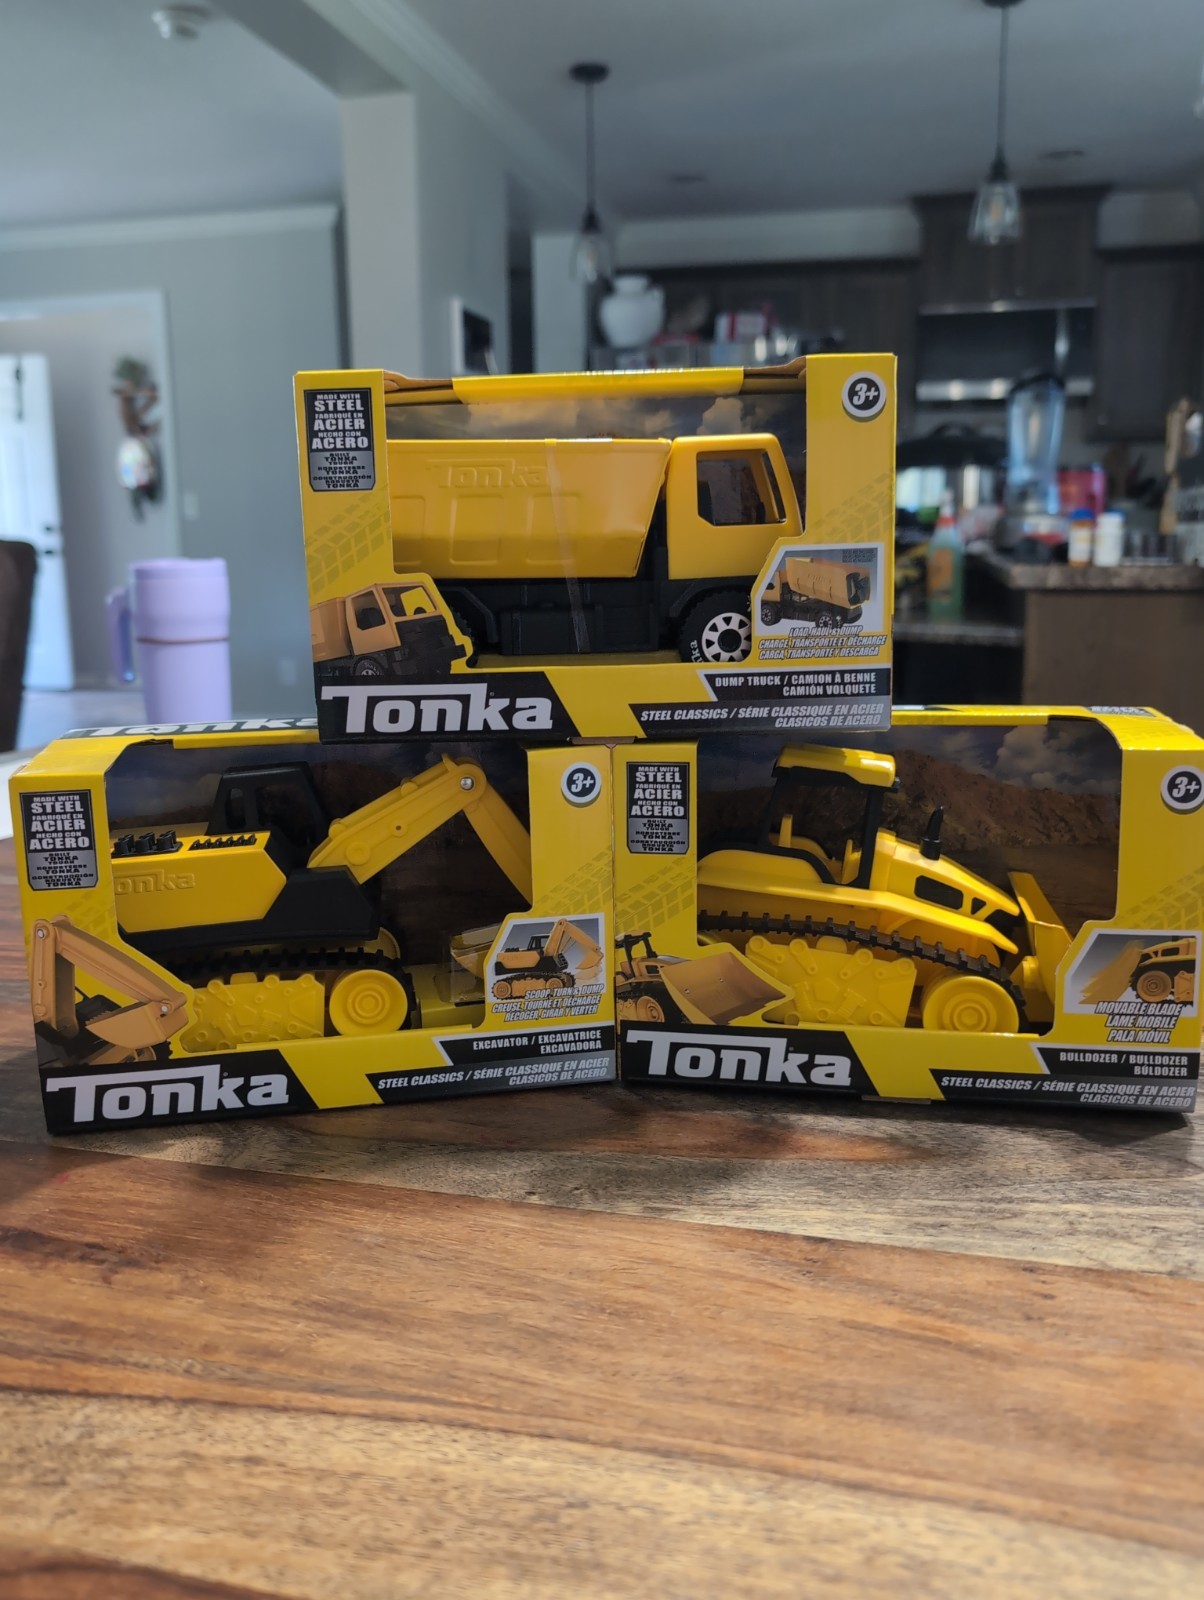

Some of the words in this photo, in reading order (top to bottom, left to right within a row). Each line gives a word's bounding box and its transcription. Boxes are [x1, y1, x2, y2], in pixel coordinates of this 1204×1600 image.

[852, 383, 879, 405] 3+
[314, 399, 364, 412] STEEL
[313, 418, 365, 431] ACIER
[311, 436, 369, 450] ACERO
[425, 458, 549, 488] Tonka
[840, 625, 863, 636] DUMP
[790, 637, 838, 648] TRANSPORTE
[838, 636, 848, 646] ET
[786, 648, 834, 659] TRANSPORTE
[839, 646, 879, 657] DESCARGA
[715, 676, 745, 687] DUMP
[746, 675, 781, 686] TRUCK
[791, 674, 833, 685] CAMION
[834, 672, 842, 684] À
[844, 672, 877, 683] BENNE
[783, 684, 824, 696] CAMIÓN
[825, 683, 877, 695] VOLQUETE
[321, 683, 553, 734] Tonka
[640, 710, 672, 721] STEEL
[673, 708, 729, 720] CLASSICS
[738, 705, 770, 718] SÉRIE
[771, 705, 833, 717] CLASSIQUE
[833, 704, 850, 715] EN
[849, 703, 885, 715] ACIER
[829, 715, 845, 726] DE
[844, 714, 882, 726] ACERO
[570, 772, 595, 793] 3+
[635, 771, 682, 783] STEEL
[633, 788, 682, 800] ACIER
[1171, 776, 1200, 798] 3+
[30, 800, 84, 814] STEEL
[630, 805, 685, 817] ACERO
[32, 813, 71, 821] FABRIQUÉ
[31, 819, 86, 832] ACIER
[29, 836, 90, 850] ACERO
[112, 869, 196, 895] onka
[553, 986, 574, 997] TURN
[580, 984, 605, 995] DUMP
[523, 999, 552, 1011] TOURNE
[552, 998, 562, 1008] ET
[541, 1008, 565, 1019] GIRAR
[570, 1004, 599, 1016] VERTER
[1095, 1001, 1147, 1015] MOVABLE
[1147, 1002, 1183, 1016] BLADE
[1105, 1014, 1136, 1028] LAME
[1135, 1015, 1179, 1029] MOBILE
[473, 1036, 529, 1050] EXCAVATOR
[538, 1029, 602, 1044] EXCAVATRICE
[1107, 1028, 1136, 1043] PALA
[1136, 1027, 1171, 1044] MÓVIL
[540, 1040, 602, 1054] EXCAVADORA
[626, 1029, 852, 1086] Tonka
[1059, 1051, 1118, 1064] BULLDOZER
[1129, 1054, 1188, 1066] BULLDOZER
[377, 1077, 409, 1089] STEEL
[410, 1071, 465, 1086] CLASSICS
[472, 1067, 505, 1080] SÉRIE
[504, 1061, 563, 1077] CLASSIQUE
[563, 1060, 578, 1071] EN
[578, 1057, 610, 1070] ACIER
[559, 1070, 573, 1081] DE
[573, 1067, 608, 1080] ACERO
[1133, 1064, 1188, 1077] BÚLDOZER
[46, 1064, 289, 1123] Tonka
[940, 1076, 974, 1087] STEEL
[975, 1078, 1033, 1091] CLASSICS
[1041, 1079, 1076, 1092] SÉRIE
[1076, 1082, 1142, 1095] CLASSIQUE
[1142, 1085, 1159, 1096] EN
[1158, 1085, 1196, 1097] ACIER
[1137, 1096, 1153, 1105] DE
[1152, 1096, 1192, 1107] ACERO
